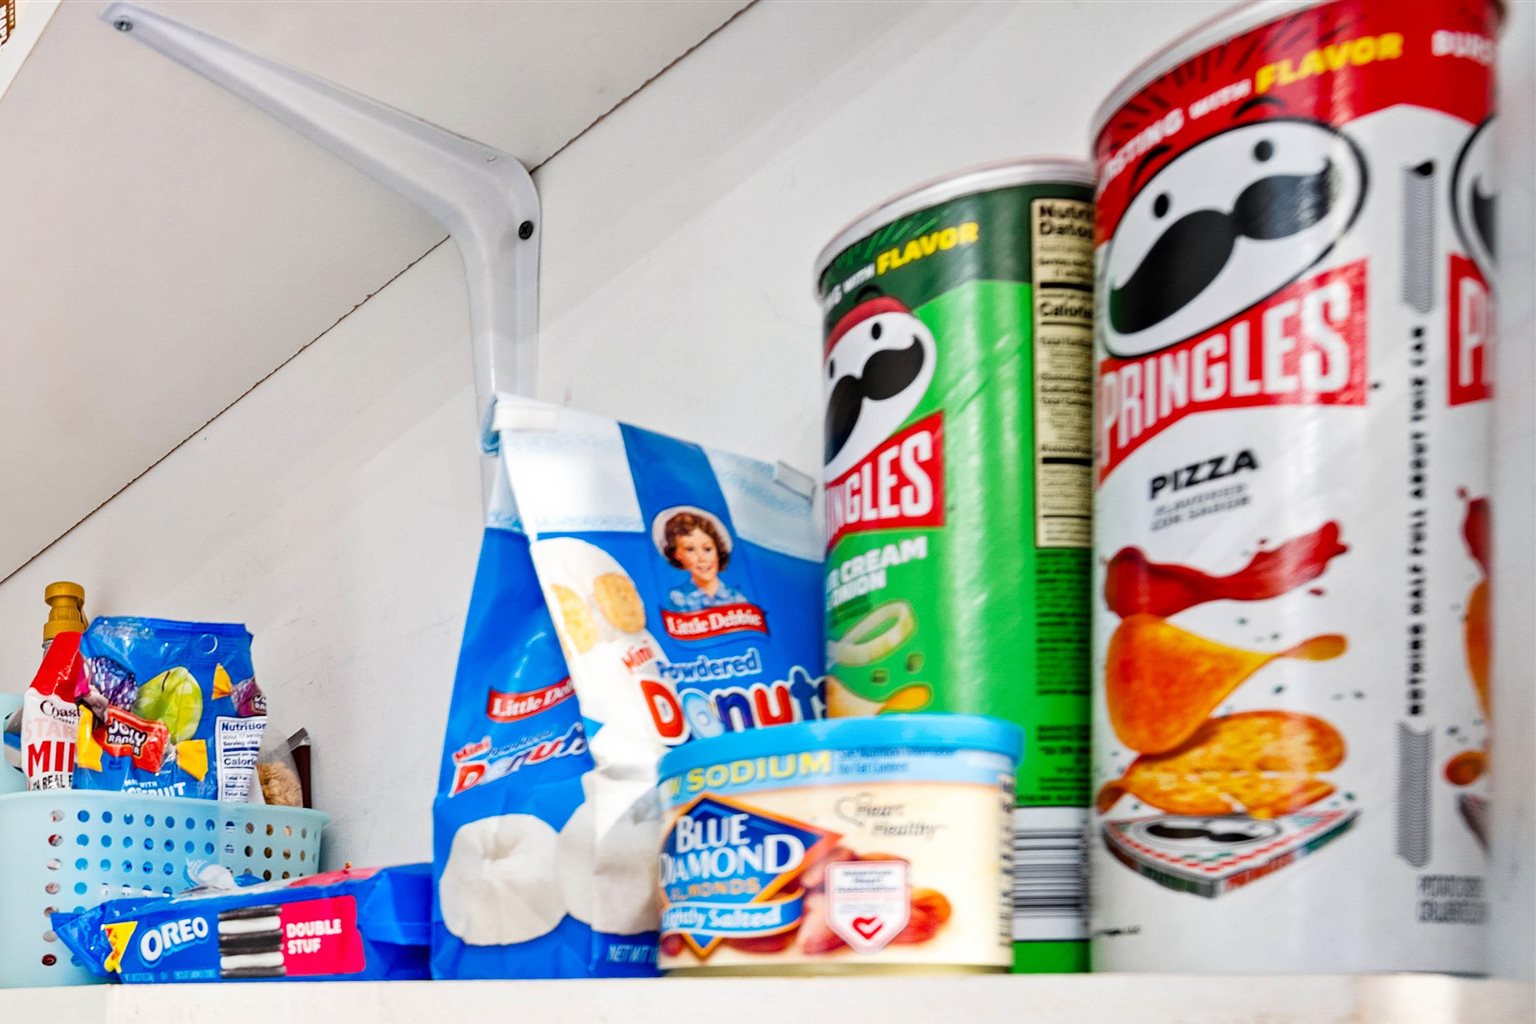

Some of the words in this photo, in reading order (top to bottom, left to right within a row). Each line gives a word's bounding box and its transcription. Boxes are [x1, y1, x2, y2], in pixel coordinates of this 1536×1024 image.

[1188, 79, 1253, 119] WITH
[1255, 32, 1404, 95] FLAVOR
[875, 221, 980, 276] FLAVOR
[1408, 326, 1428, 368] CAN
[1096, 280, 1352, 468] PRINGLES
[1149, 449, 1260, 500] PIZZA
[1408, 429, 1428, 500] ABOUT
[1408, 509, 1428, 557] FULL
[840, 534, 928, 584] CREAM
[1408, 565, 1428, 615] HALF
[665, 612, 710, 636] Little
[709, 608, 763, 630] Debbie
[656, 646, 763, 683] Powdered
[491, 694, 544, 718] Little
[687, 751, 833, 793] SODIUM
[855, 799, 904, 817] Heart
[675, 813, 751, 854] BLUE
[871, 820, 940, 839] Healthy
[658, 833, 806, 888] DIAMOND
[286, 917, 343, 939] DOUBLE
[707, 905, 782, 928] Salted
[140, 915, 209, 963] OREO
[287, 936, 322, 955] STUF
